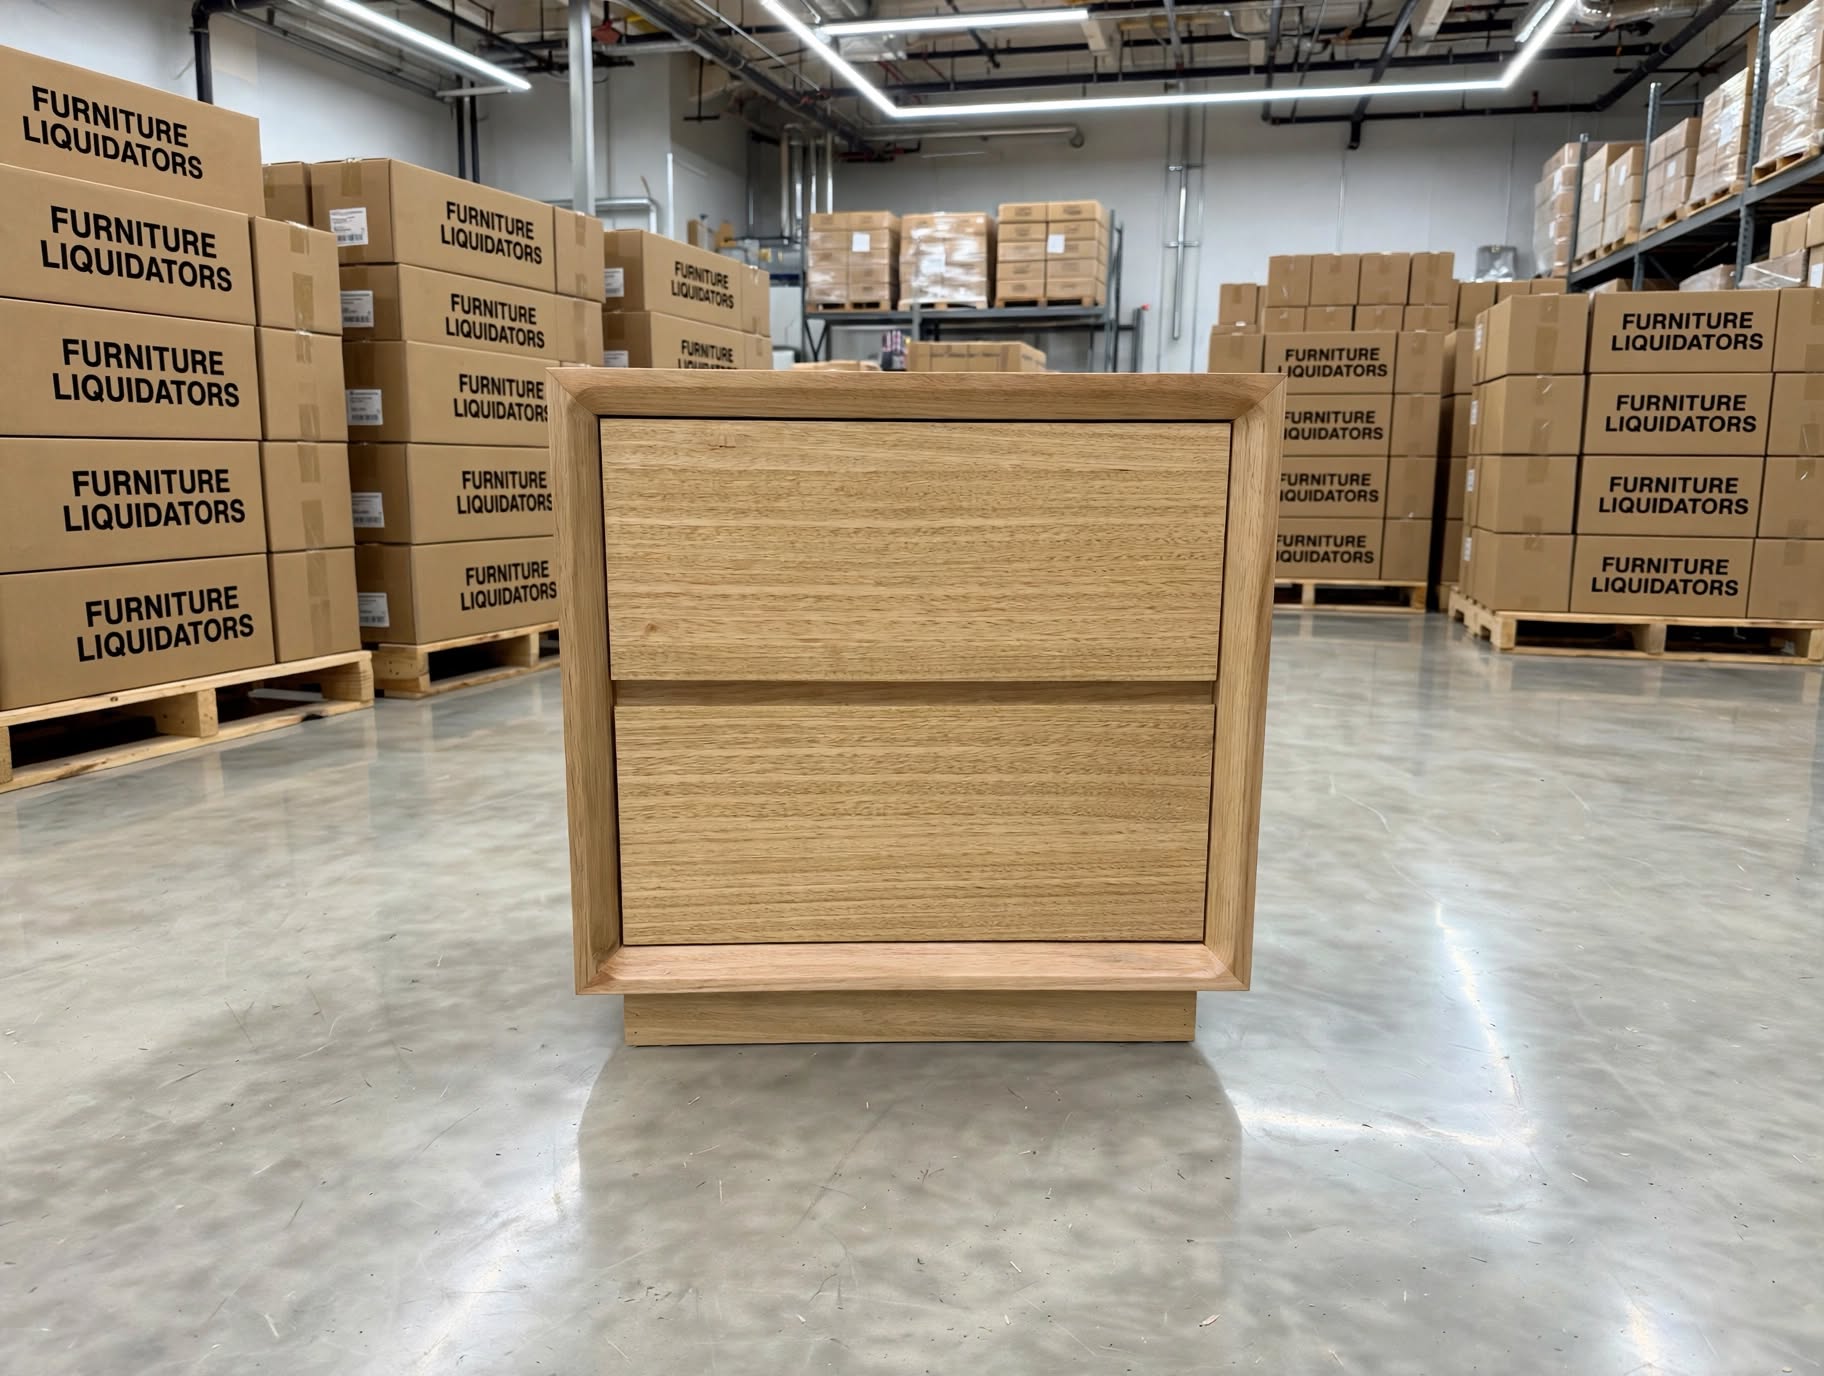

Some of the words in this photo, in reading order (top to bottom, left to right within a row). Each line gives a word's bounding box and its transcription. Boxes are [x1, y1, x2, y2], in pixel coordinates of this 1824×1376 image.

[32, 86, 188, 147] FURNITURE
[23, 117, 202, 179] LIQUIDATORS
[51, 206, 216, 258] FURNITURE
[447, 201, 534, 240] FURNITURE
[441, 224, 542, 264] LIQUIDATORS
[41, 240, 232, 291] LIQUIDATORS
[675, 261, 728, 289] FURNITURE
[671, 280, 733, 309] LIQUIDATORS
[451, 294, 536, 324] FURNITURE
[1623, 312, 1753, 330] FURNITURE
[446, 317, 544, 348] LIQUIDATORS
[1612, 333, 1763, 351] LIQUIDATORS
[63, 339, 224, 375] FURNITURE
[1286, 348, 1379, 361] FURNITURE
[53, 373, 239, 407] LIQUIDATORS
[460, 374, 544, 399] FURNITURE
[1617, 395, 1746, 411] FURNITURE
[1284, 427, 1383, 440] IQUIDATORS
[1606, 416, 1756, 432] LIQUIDATORS
[73, 469, 230, 496] FURNITURE
[462, 471, 547, 489] FURNITURE
[1610, 477, 1738, 493] FURNITURE
[1280, 489, 1378, 502] IQUIDATORS
[1599, 497, 1748, 514] LIQUIDATORS
[64, 499, 245, 531] LIQUIDATORS
[1276, 550, 1374, 563] IQUIDATORS
[1603, 557, 1729, 575] FURNITURE
[466, 561, 549, 586] FURNITURE
[1592, 577, 1738, 596] LIQUIDATORS
[86, 586, 238, 627] FURNITURE
[461, 582, 556, 611] LIQUIDATORS
[77, 614, 253, 662] LIQUIDATORS
